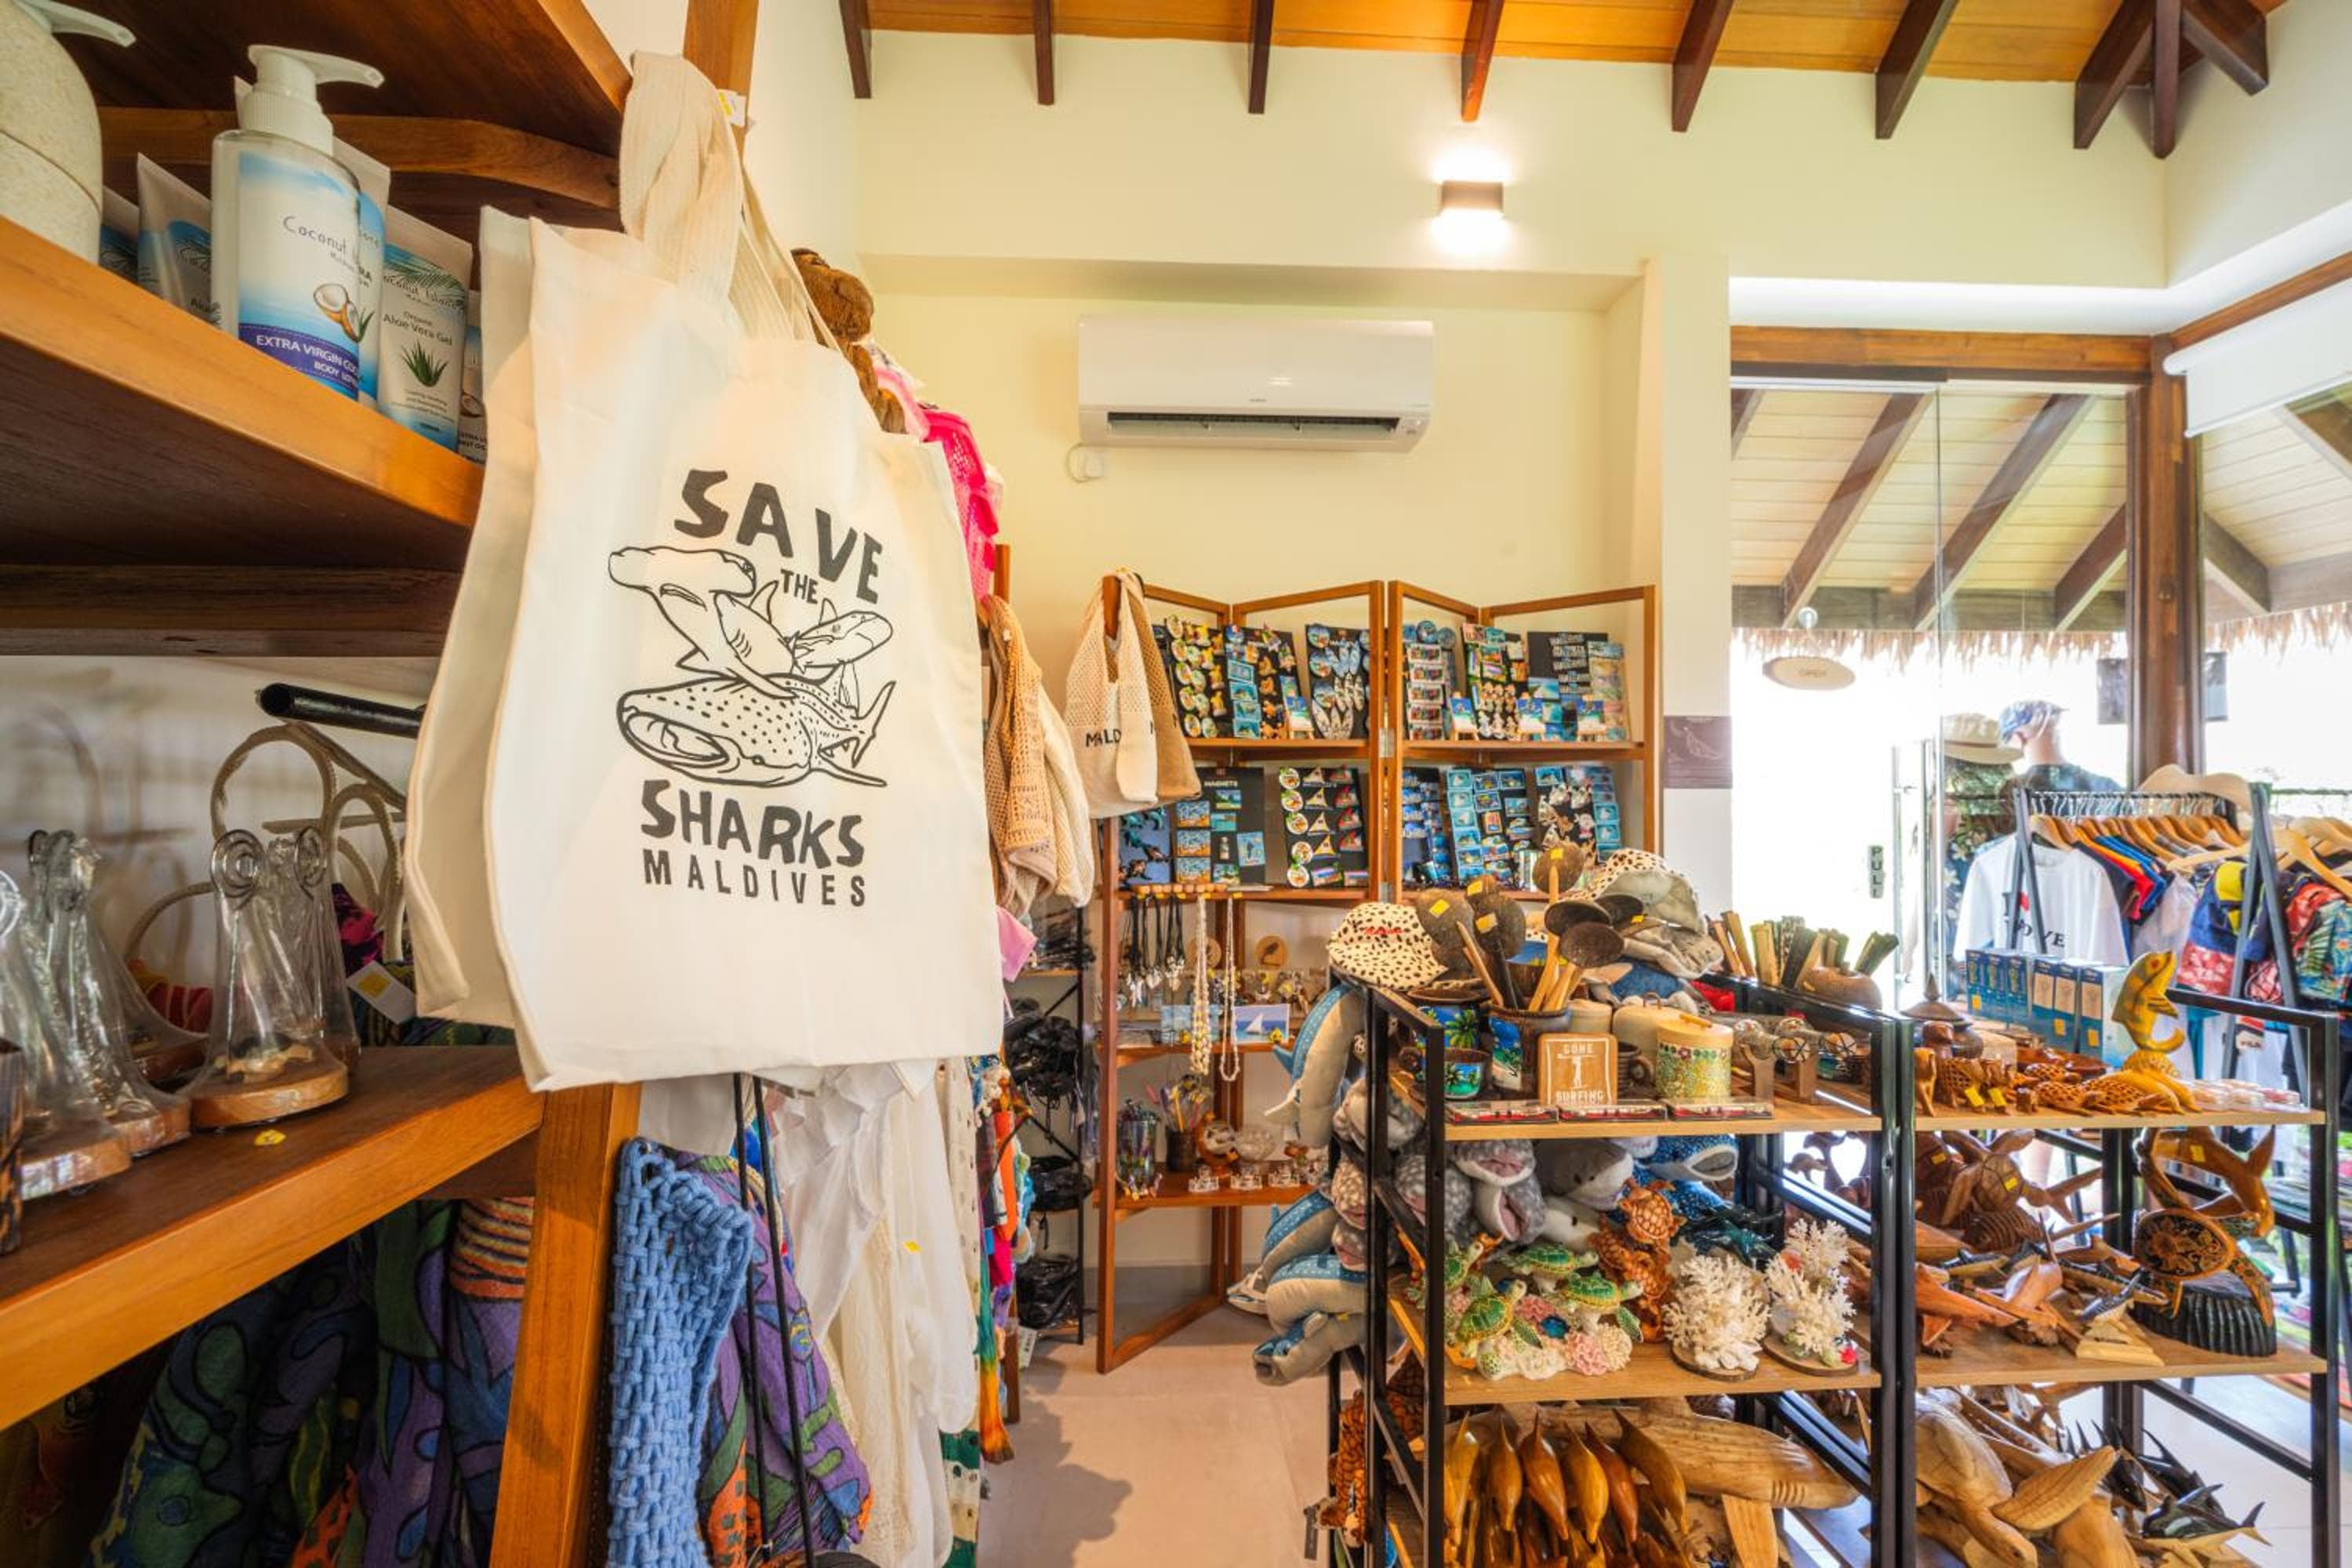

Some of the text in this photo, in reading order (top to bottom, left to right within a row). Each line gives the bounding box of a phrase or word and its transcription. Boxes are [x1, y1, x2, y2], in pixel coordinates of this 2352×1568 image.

[283, 216, 347, 254] Coconut
[383, 314, 452, 346] Aloe Vera Gel
[256, 335, 301, 352] EXTRA
[302, 343, 343, 368] VIRGIN
[314, 361, 340, 376] BODY
[674, 469, 884, 604] SAVE
[781, 568, 818, 604] THE
[641, 779, 864, 869] SHARKS
[643, 848, 866, 907] MALDIVES
